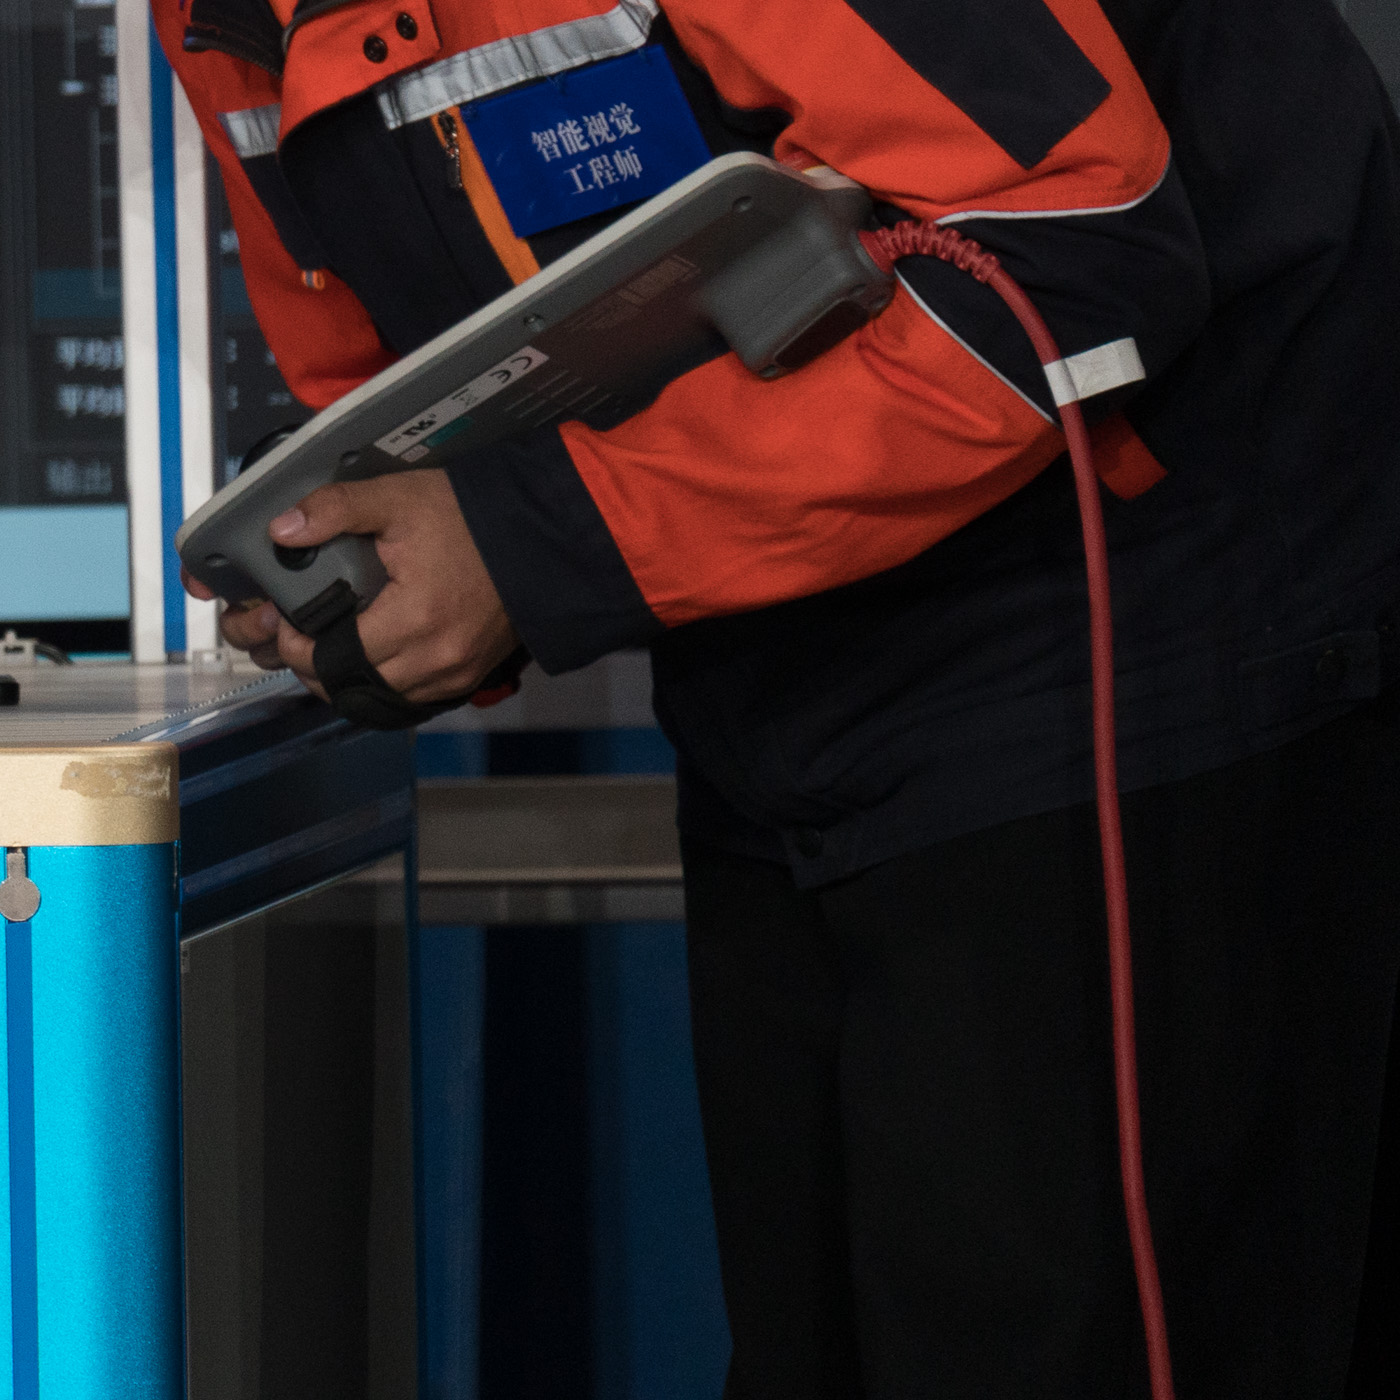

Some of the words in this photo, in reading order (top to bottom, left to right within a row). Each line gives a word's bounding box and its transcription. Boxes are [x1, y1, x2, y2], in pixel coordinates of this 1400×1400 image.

[531, 101, 642, 163] 智能视觉
[563, 144, 644, 195] 工程师
